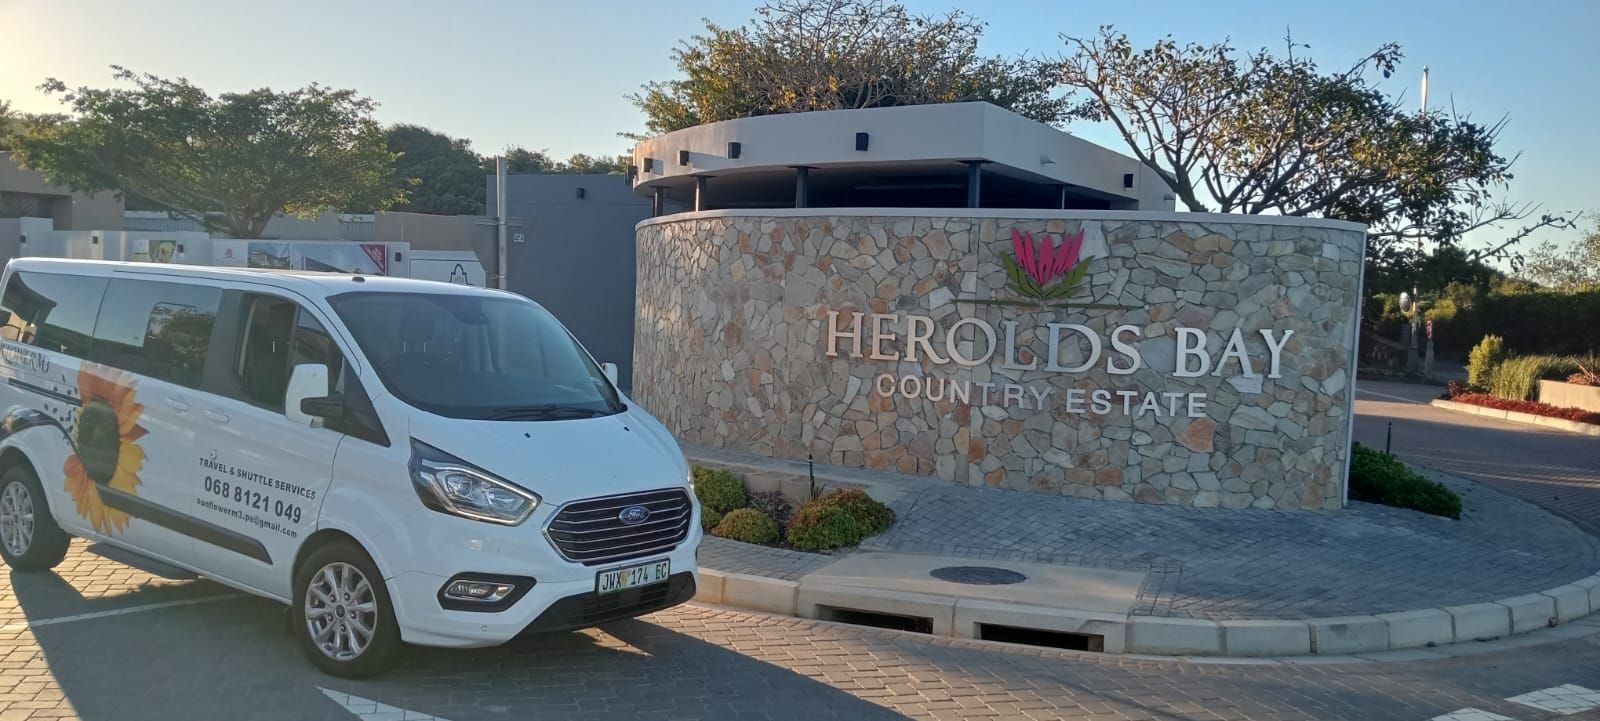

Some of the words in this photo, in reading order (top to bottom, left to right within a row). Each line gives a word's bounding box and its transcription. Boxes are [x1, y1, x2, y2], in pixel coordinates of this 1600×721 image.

[825, 310, 1142, 376] HEROLDS
[1173, 327, 1295, 379] BAY
[876, 373, 1054, 411] COUNTRY
[1065, 388, 1208, 418] ESTATE
[199, 457, 228, 474] TRAVEL
[229, 466, 235, 476] &
[236, 468, 274, 487] SHUTTLE
[274, 480, 317, 500] SERVICES
[204, 475, 230, 499] 068
[234, 486, 270, 513] 8121
[274, 499, 302, 524] 049
[602, 571, 623, 591] JWX
[630, 567, 649, 586] 174
[655, 562, 668, 581] EC
